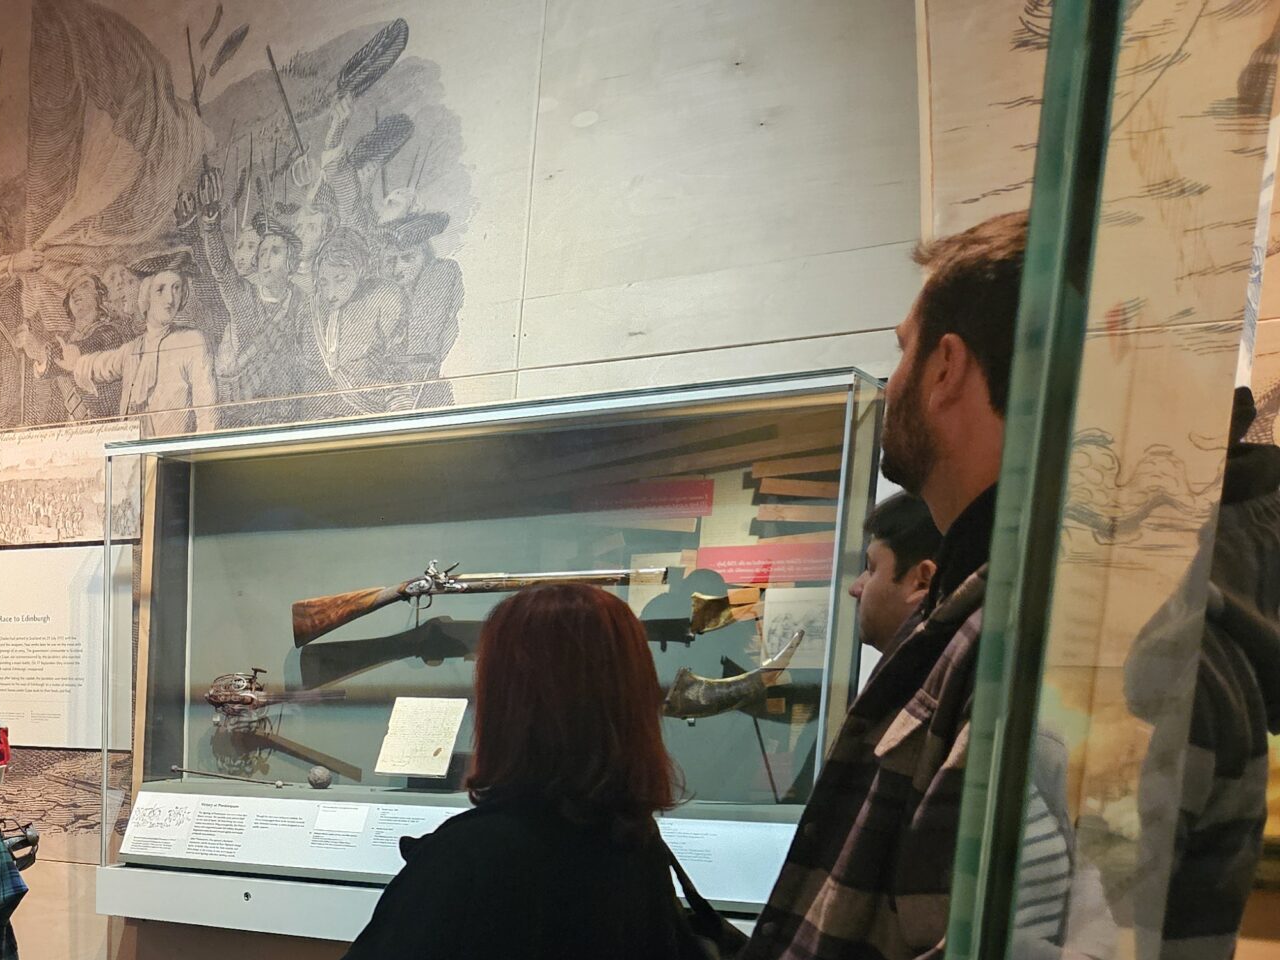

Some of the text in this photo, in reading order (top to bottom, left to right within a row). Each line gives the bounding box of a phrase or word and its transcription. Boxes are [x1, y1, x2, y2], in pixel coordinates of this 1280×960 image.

[0, 615, 12, 623] Race
[14, 615, 20, 623] to
[22, 614, 51, 624] Edinburgh
